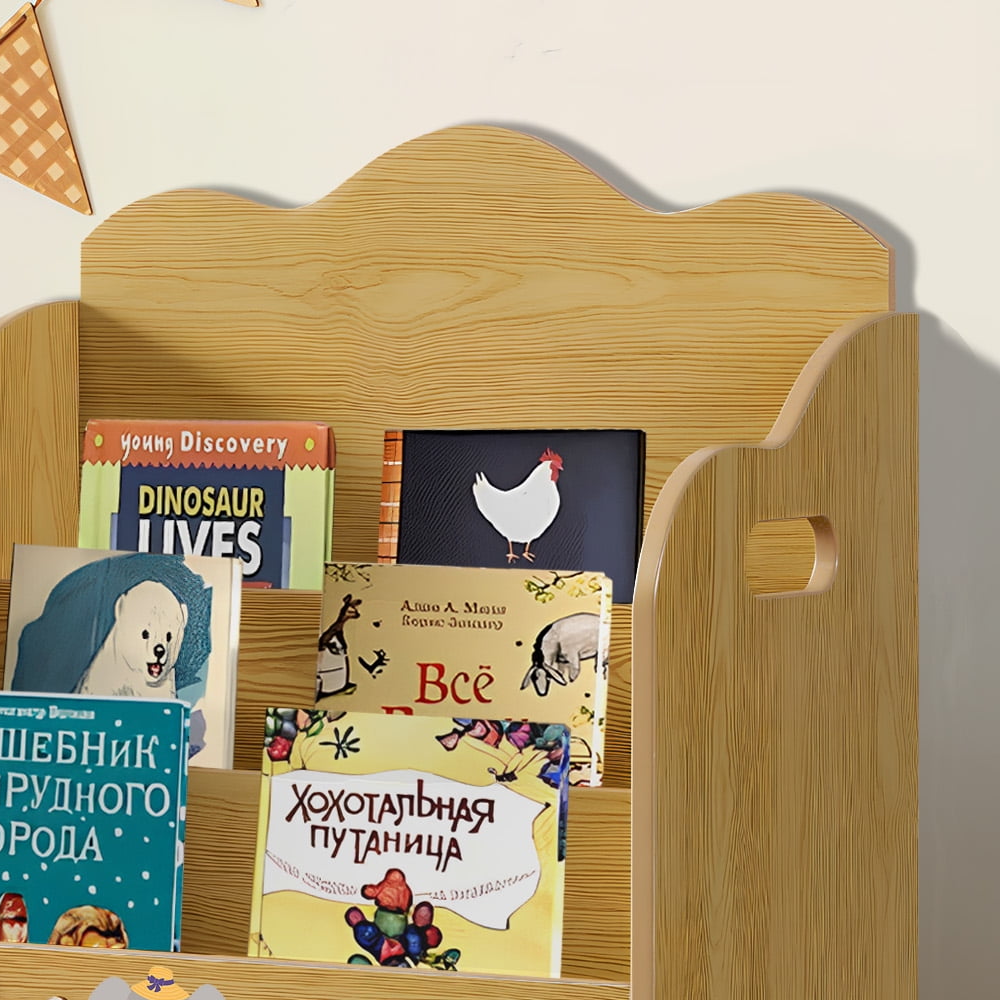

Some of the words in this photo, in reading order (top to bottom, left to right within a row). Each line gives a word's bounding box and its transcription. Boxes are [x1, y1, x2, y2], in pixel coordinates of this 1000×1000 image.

[180, 430, 288, 460] Discovery
[138, 485, 264, 518] DINOSAUR
[414, 662, 494, 705] Всё
[310, 824, 463, 873] ПУТАНИЦА
